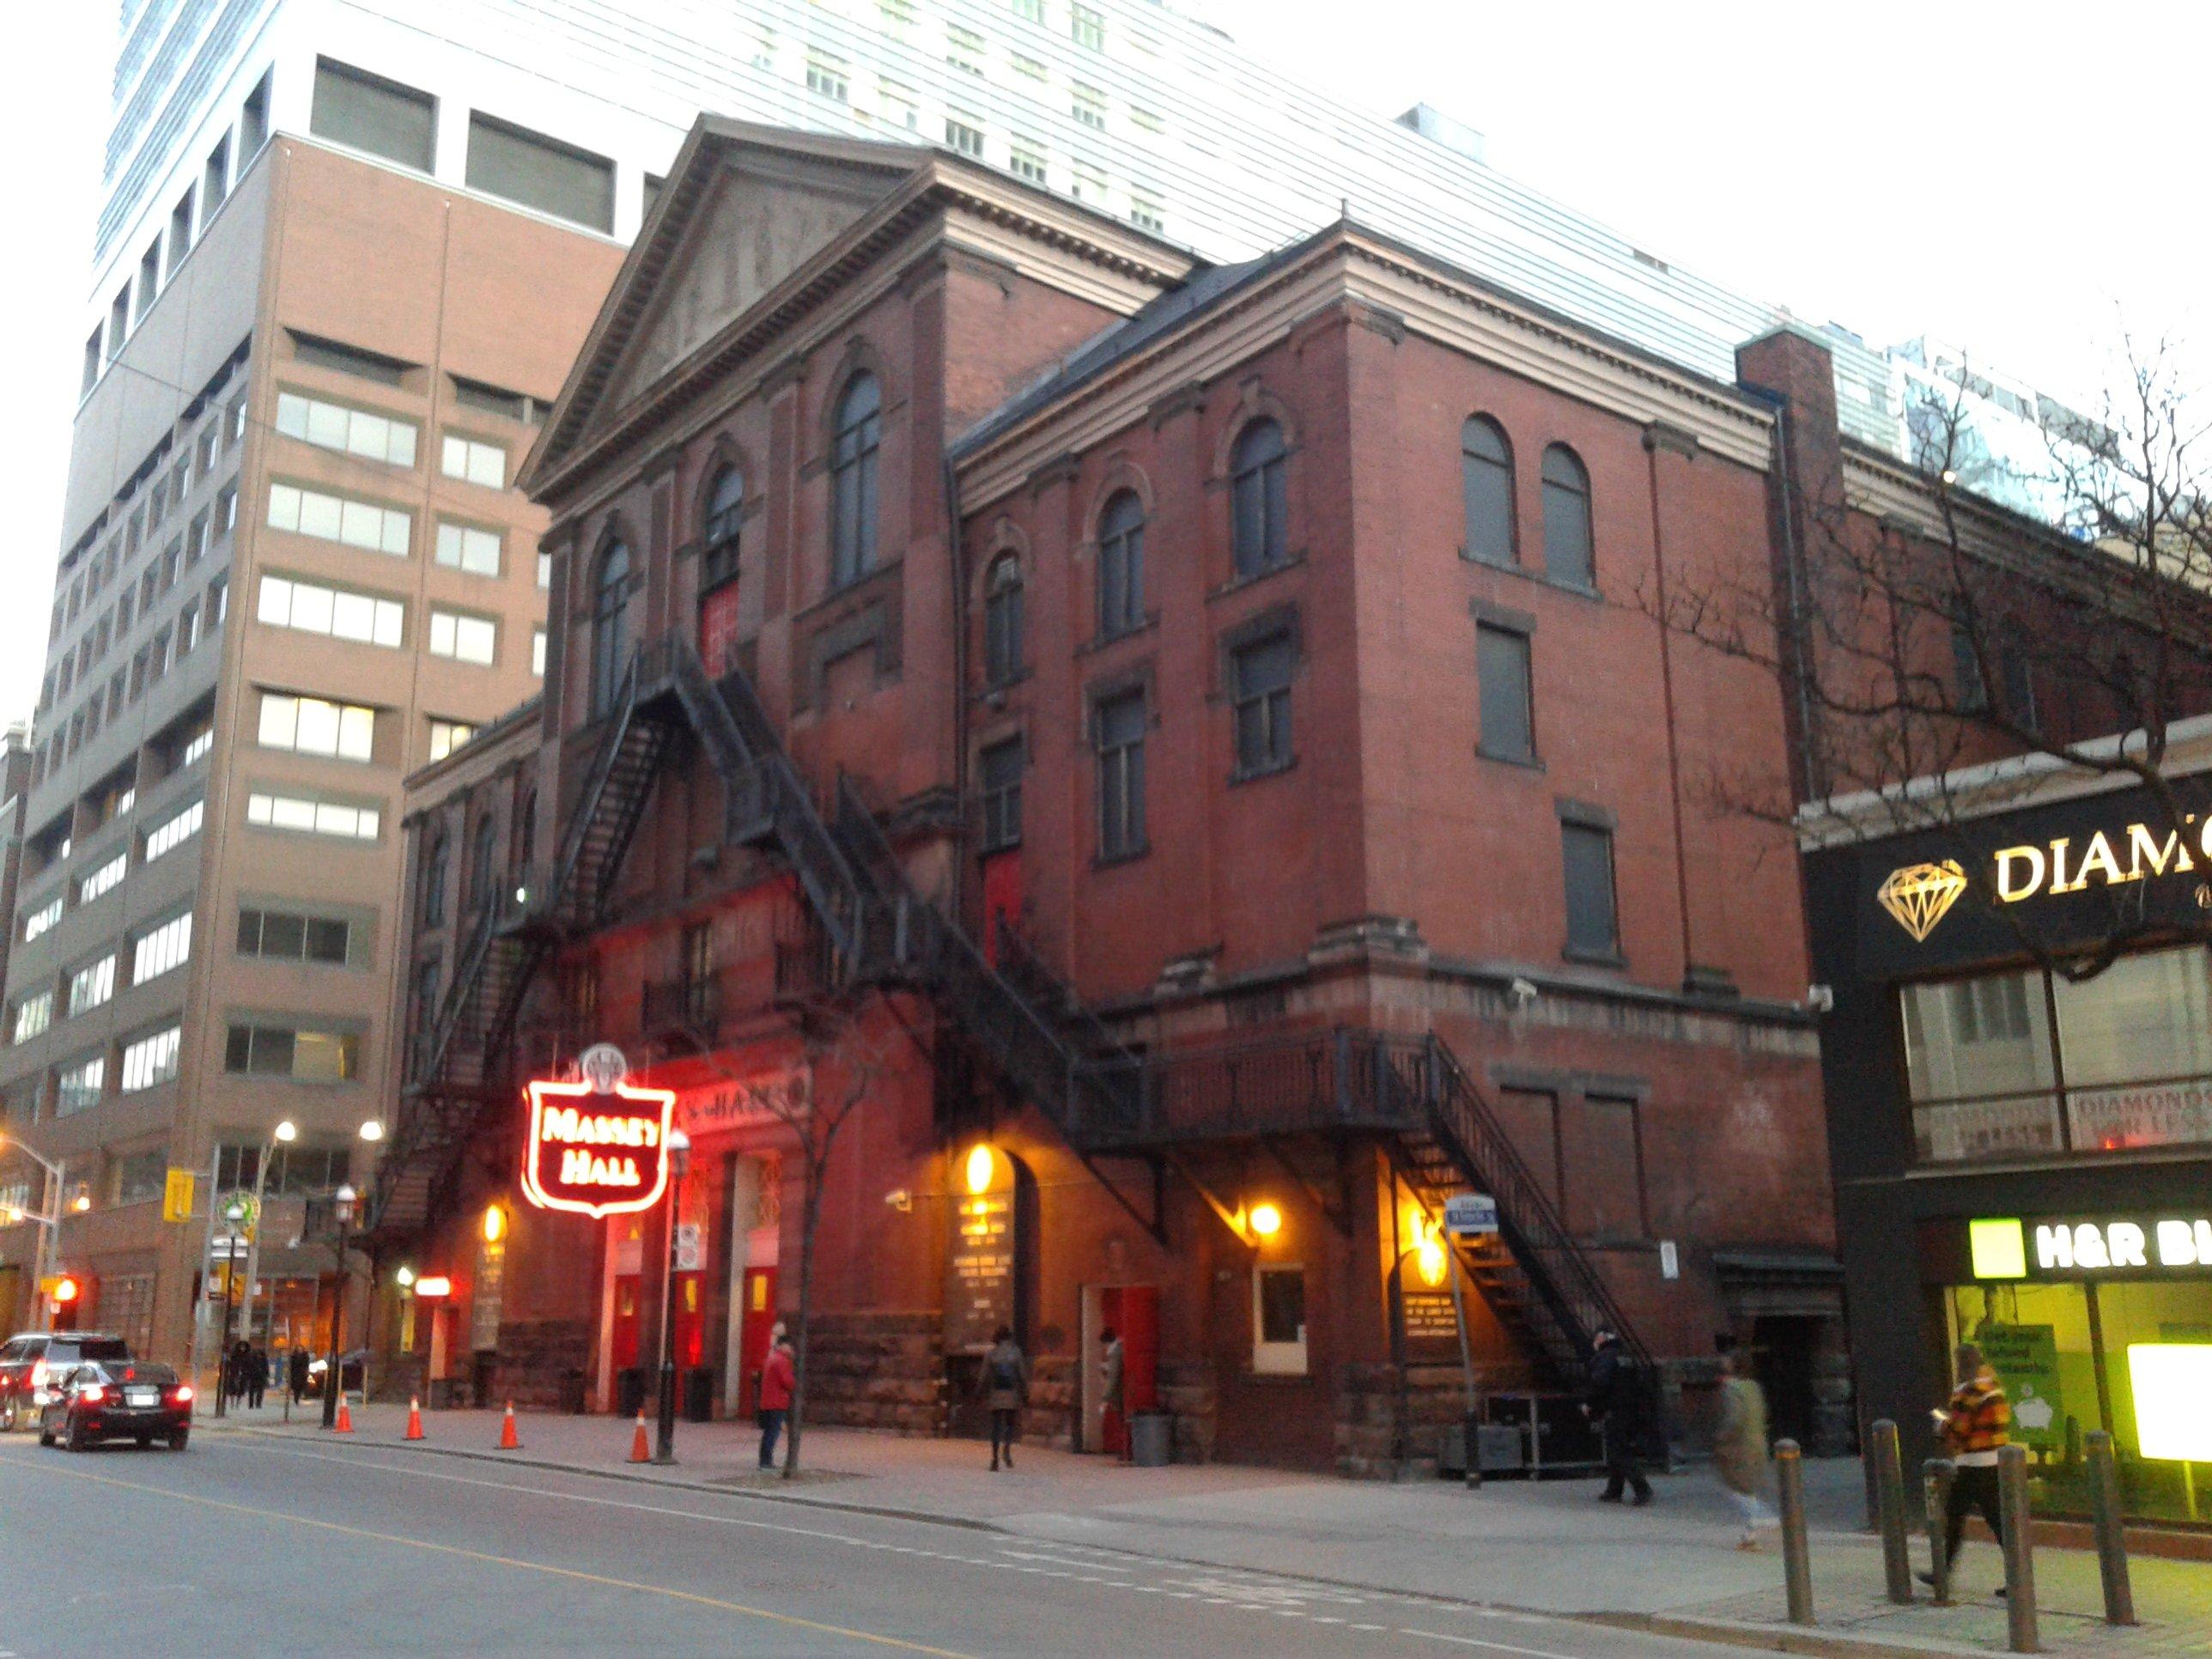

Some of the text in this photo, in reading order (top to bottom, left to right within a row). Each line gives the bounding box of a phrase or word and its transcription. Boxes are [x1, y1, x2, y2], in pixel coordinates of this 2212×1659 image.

[1993, 813, 2212, 903] DIAM
[542, 1107, 659, 1146] MASSEY
[561, 1149, 641, 1186] HALL
[2036, 1222, 2147, 1268] H&R
